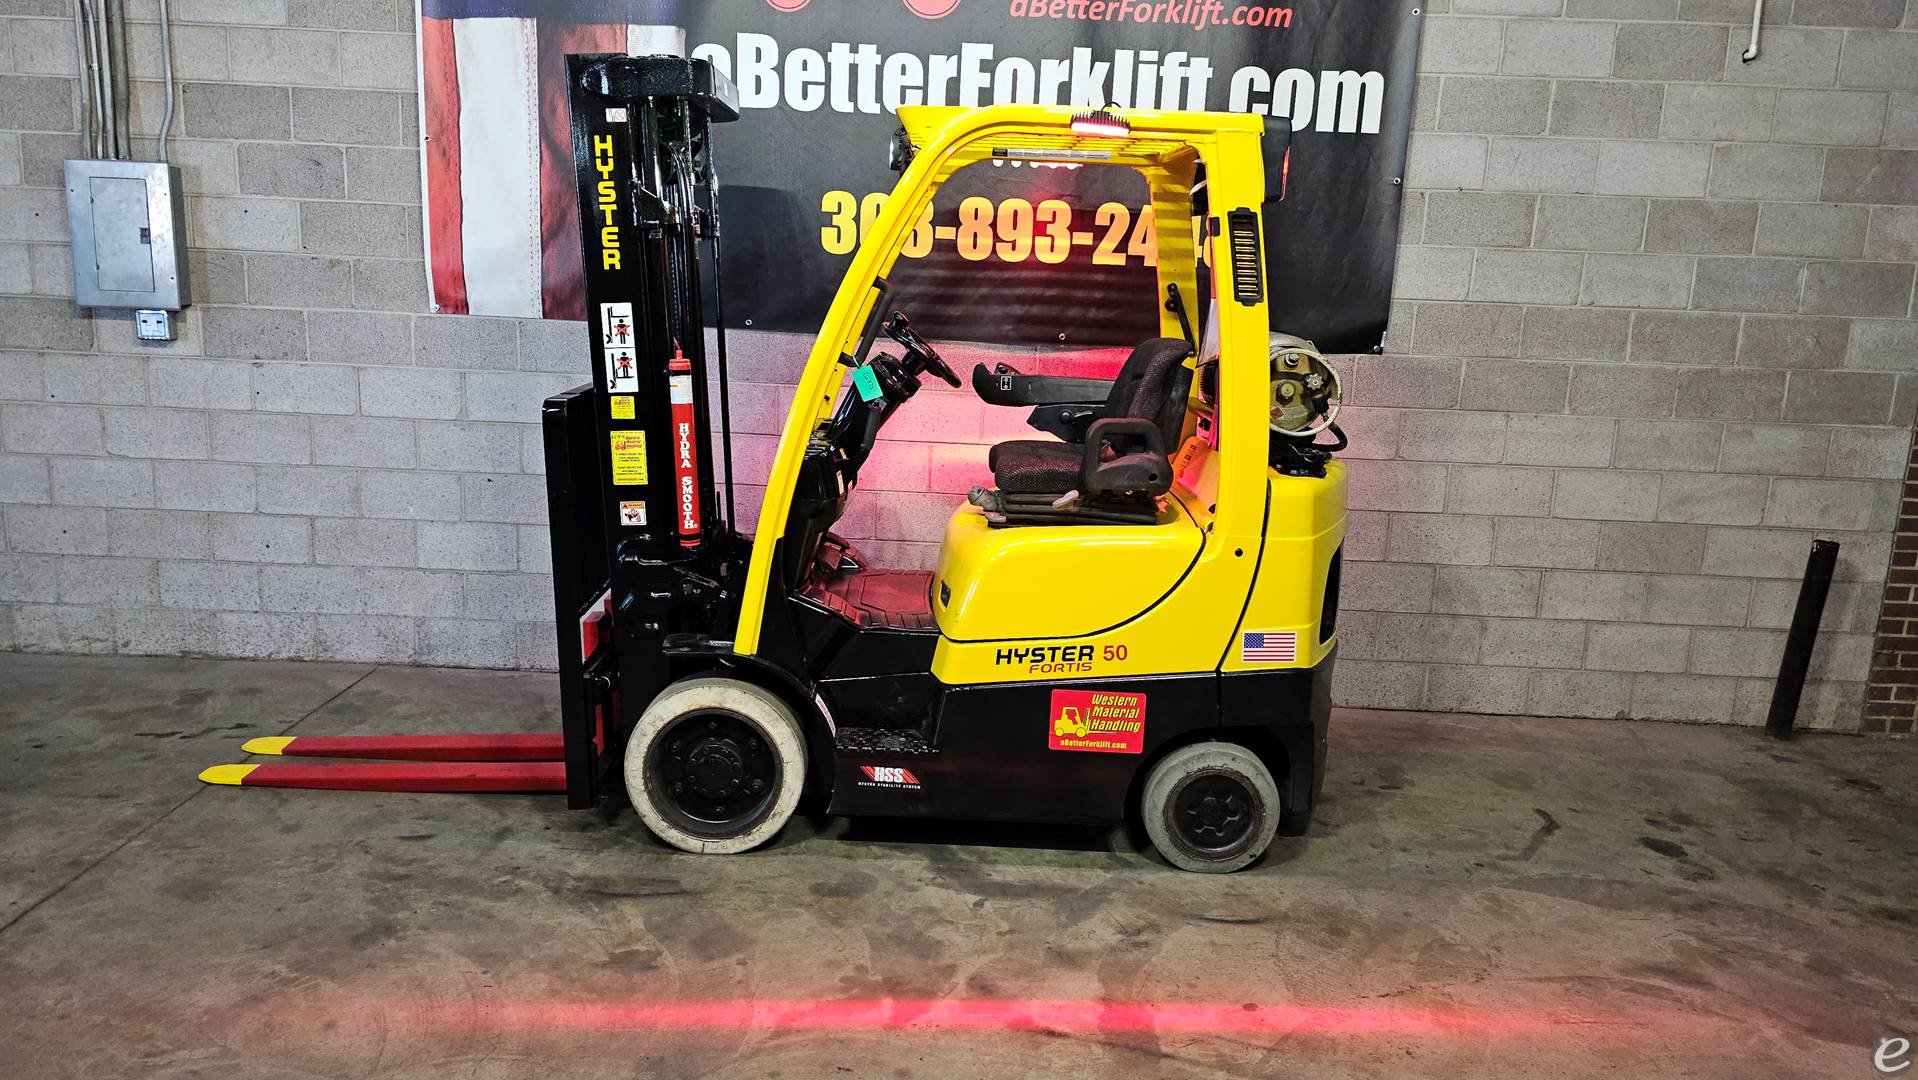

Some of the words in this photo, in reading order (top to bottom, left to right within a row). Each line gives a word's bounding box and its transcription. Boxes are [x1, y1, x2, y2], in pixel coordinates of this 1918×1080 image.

[594, 135, 621, 270] HYSTER
[820, 190, 1211, 269] 33-893-24
[679, 423, 692, 468] HYDRA
[996, 645, 1095, 665] HYSTER
[1103, 645, 1128, 661] 50
[1029, 662, 1093, 673] FORTIS
[1092, 694, 1138, 706] Western
[1092, 706, 1140, 719] Material
[1090, 720, 1141, 733] Handling
[874, 766, 904, 783] HSS
